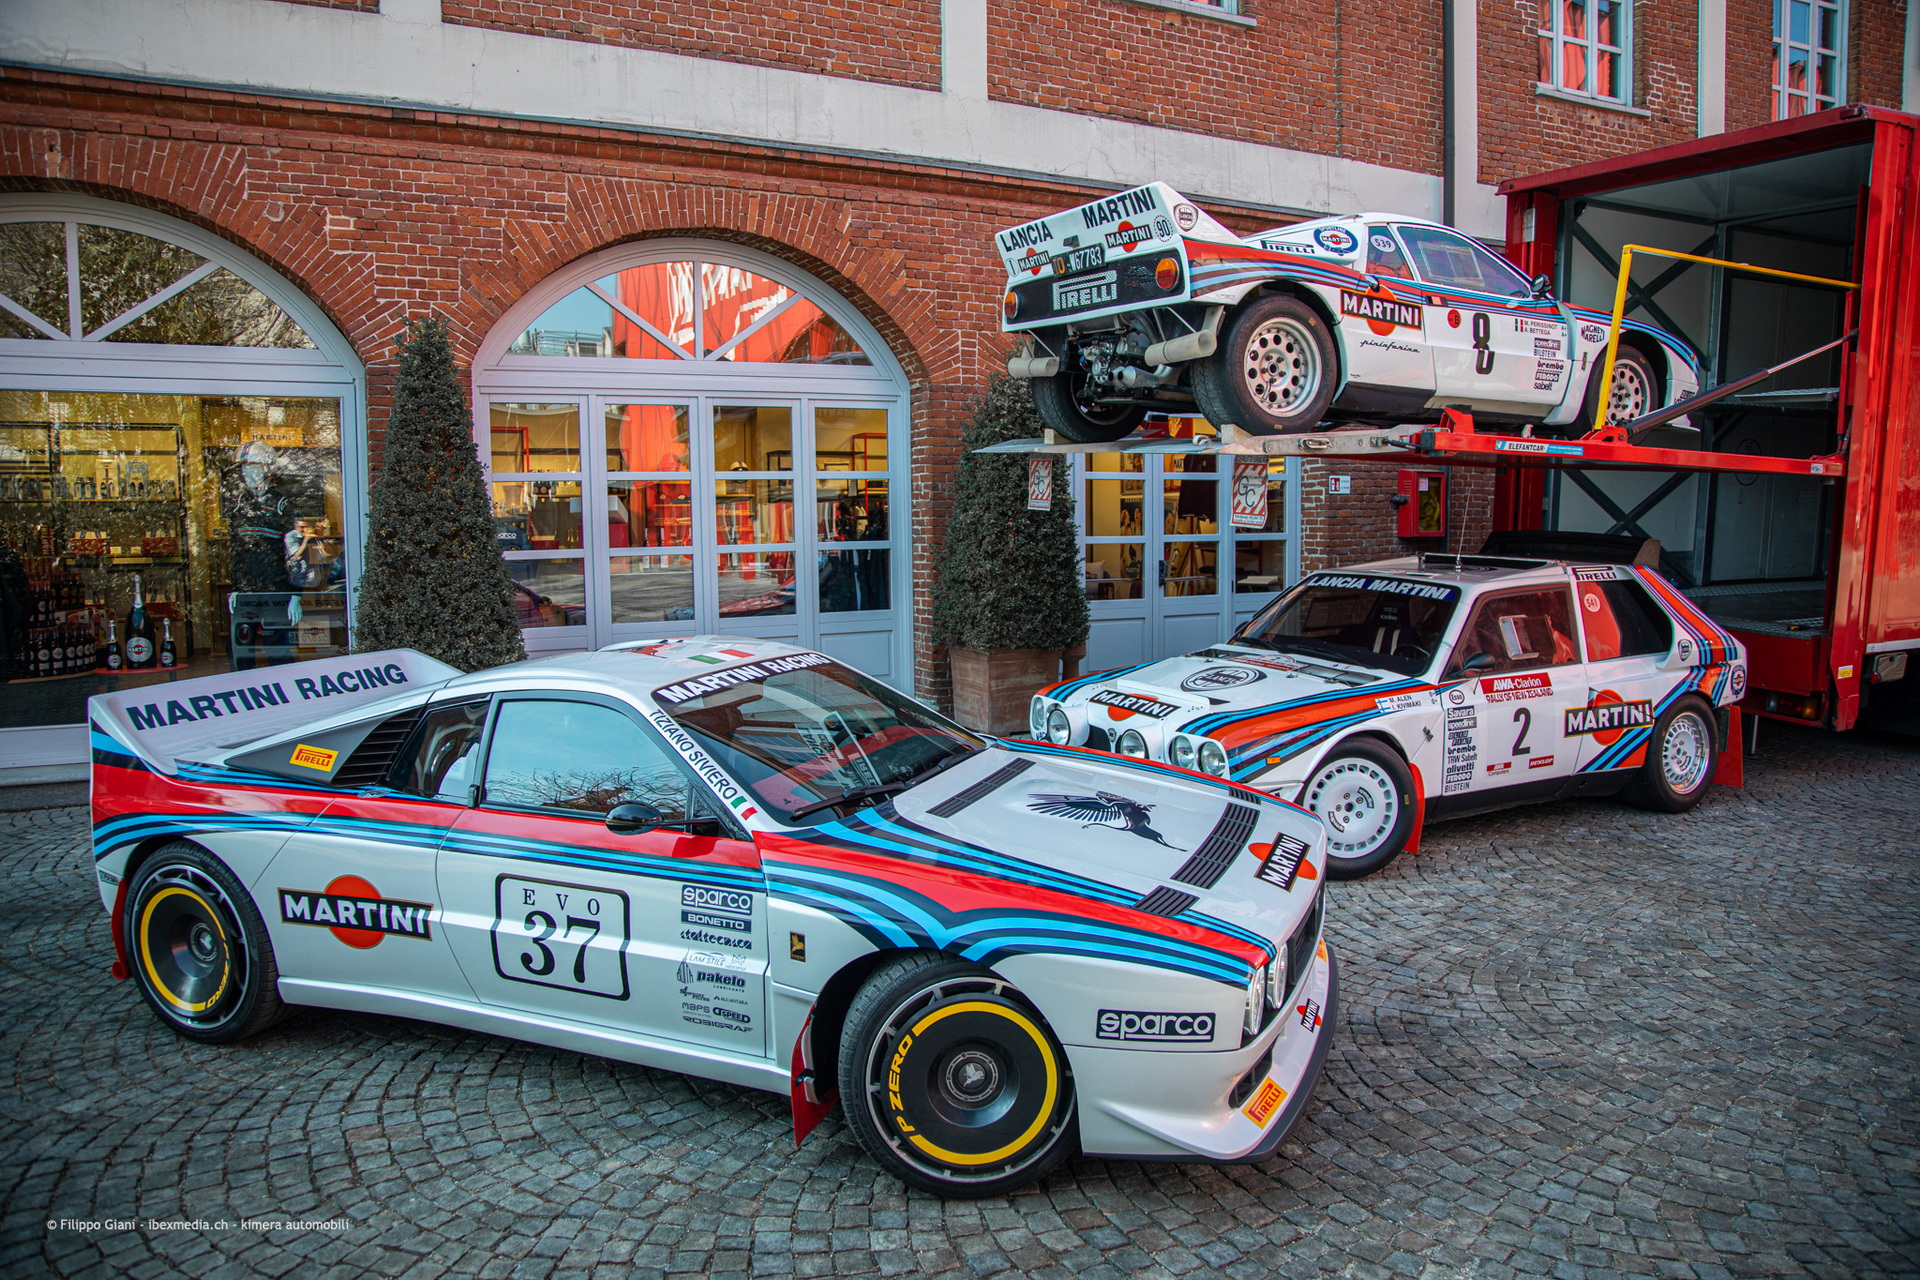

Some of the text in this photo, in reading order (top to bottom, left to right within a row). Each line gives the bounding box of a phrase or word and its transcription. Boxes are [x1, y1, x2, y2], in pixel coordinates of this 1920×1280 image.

[1000, 187, 1156, 252] LANCIA MARTINI
[1156, 219, 1171, 238] 90
[1106, 226, 1152, 247] MARTINI
[1374, 238, 1391, 248] 539
[1261, 239, 1315, 254] PIRELLI
[1019, 252, 1050, 272] MARTINI
[1053, 270, 1117, 310] PIRELLI
[1343, 293, 1419, 326] MARTINI
[1360, 339, 1420, 353] pininfarina
[1472, 312, 1495, 375] 8
[1534, 348, 1556, 358] BILSTEIN
[1537, 360, 1564, 370] brembo
[1536, 373, 1558, 381] FERODO
[1508, 443, 1545, 453] ELEFANTCAR
[1572, 567, 1617, 580] PIRELLI
[1307, 576, 1452, 600] LANCIA MARTINI
[1587, 598, 1598, 608] 541
[657, 653, 832, 703] MARTINI RACING
[1493, 676, 1542, 691] AWA-Clarion
[126, 663, 408, 731] MARTINI RACING
[1093, 690, 1175, 717] MARTINI
[1486, 688, 1553, 703] RALLY OF NEW ZEALAND
[1448, 708, 1474, 718] Savara
[1568, 703, 1651, 733] MARTINI
[1512, 707, 1531, 756] 2
[295, 748, 333, 768] PIRELLI
[650, 709, 738, 800] TIZIANO SIVIERO
[1448, 745, 1476, 755] brembo
[1447, 762, 1474, 773] olivetti
[1448, 755, 1460, 764] TRW
[1530, 758, 1553, 766] DUNLOP
[1447, 772, 1471, 782] FERODO
[1445, 782, 1470, 793] BILSTEIN
[1261, 834, 1306, 888] MARTINI
[683, 887, 750, 910] sparco
[284, 894, 426, 934] MARTINI
[688, 913, 744, 930] BONETTO
[520, 911, 601, 984] 37
[689, 955, 726, 967] LAM STILE
[696, 971, 746, 987] pakelo
[682, 1002, 710, 1014] maps
[1302, 1000, 1320, 1031] MARTINI
[682, 1015, 753, 1033] ROBIGRAF
[1100, 1012, 1213, 1040] sparco
[888, 1034, 915, 1133] P ZERO
[1248, 1083, 1282, 1122] PIRELLI
